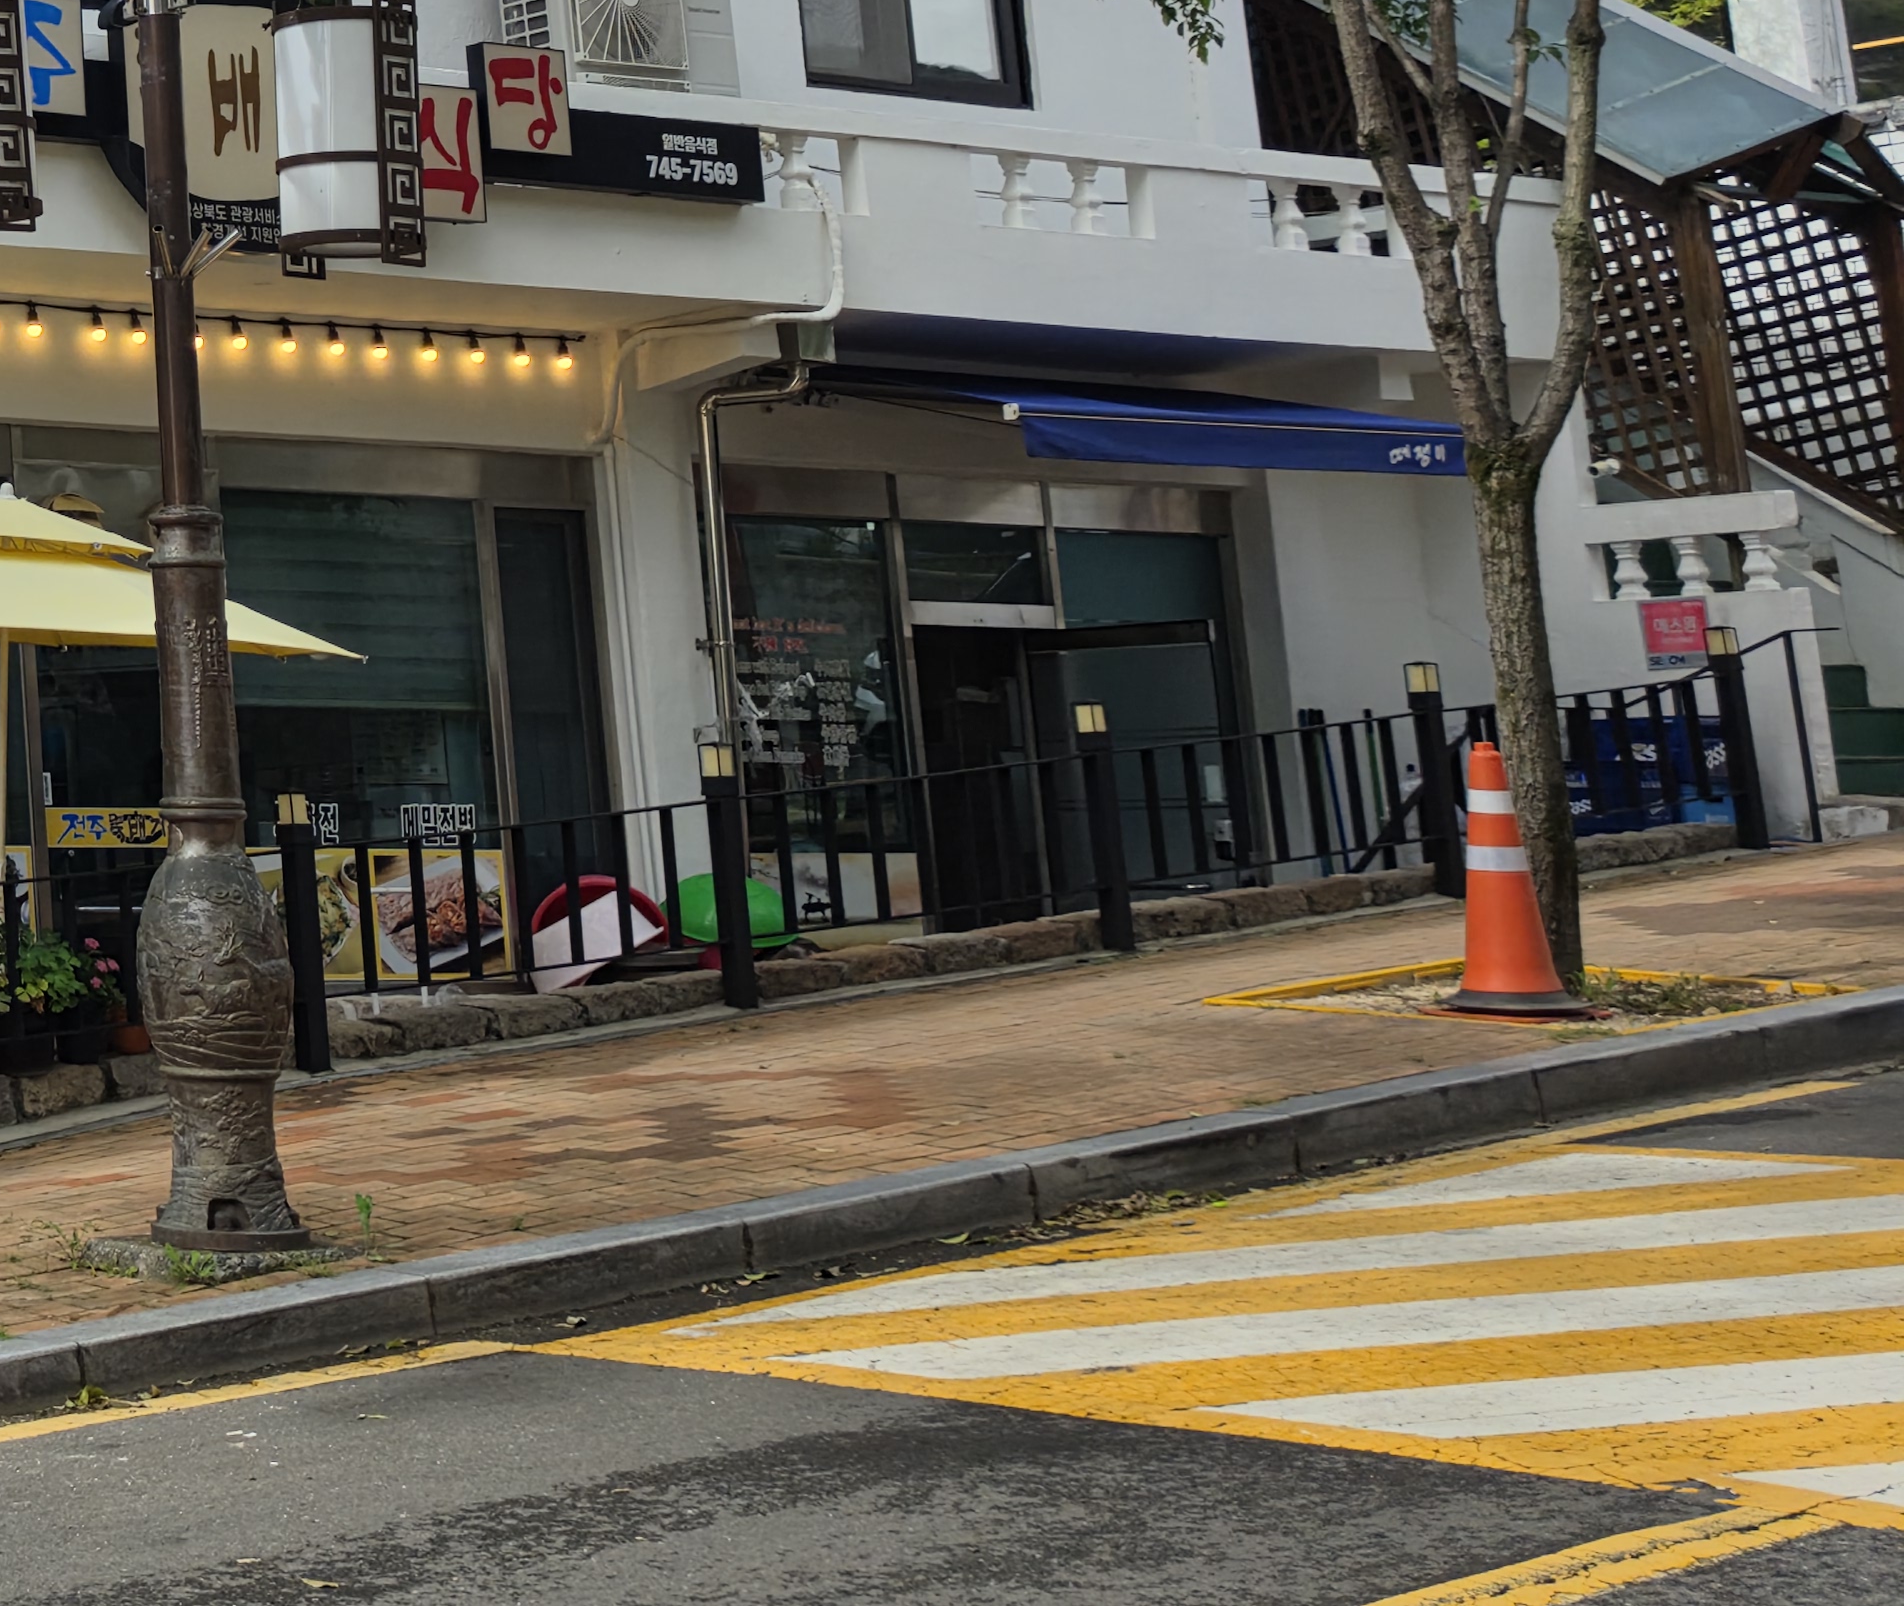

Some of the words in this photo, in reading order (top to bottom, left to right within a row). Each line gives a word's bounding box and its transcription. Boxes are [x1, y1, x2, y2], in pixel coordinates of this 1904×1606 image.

[661, 132, 719, 156] 일반음식점
[645, 154, 740, 187] 745-7569
[57, 813, 108, 844] 전주
